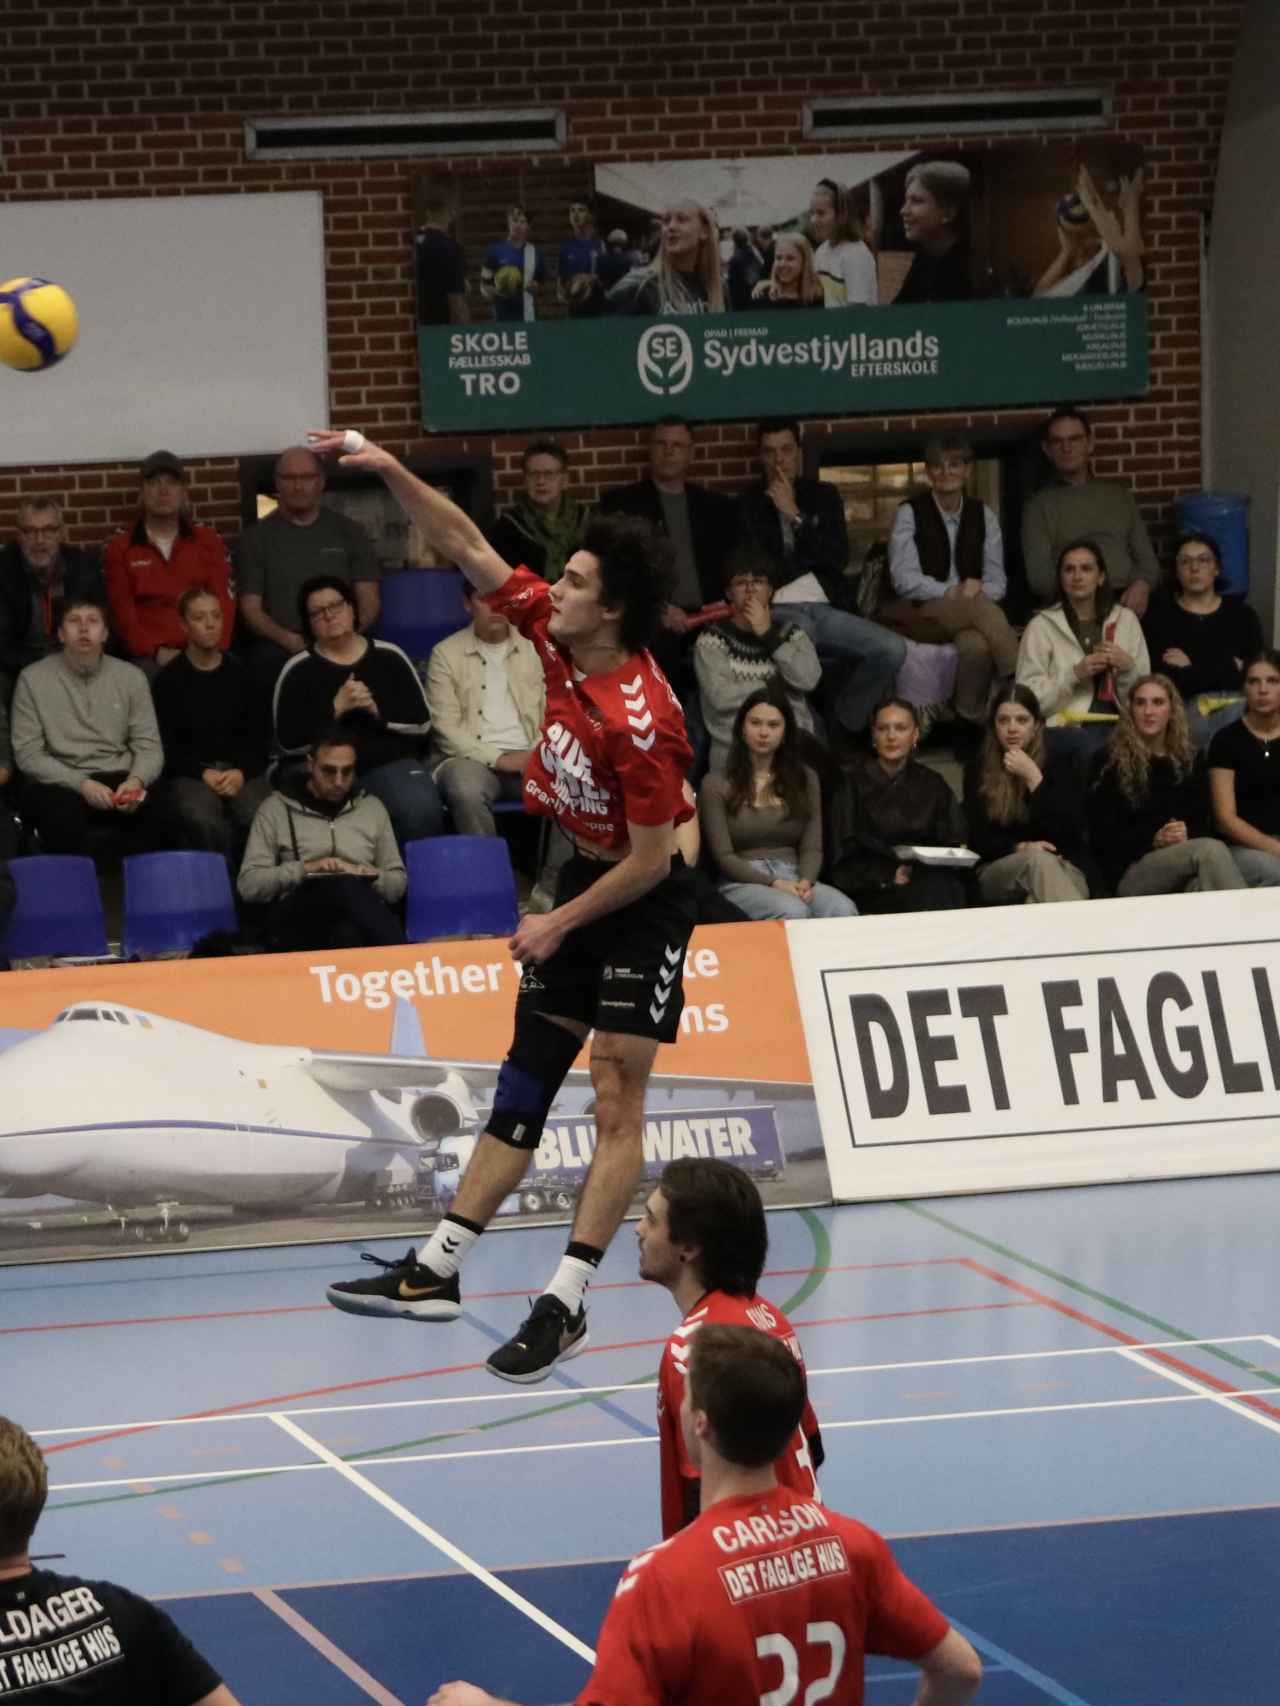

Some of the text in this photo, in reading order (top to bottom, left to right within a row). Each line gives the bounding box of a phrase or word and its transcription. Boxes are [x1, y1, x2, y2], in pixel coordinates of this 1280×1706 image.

[448, 353, 531, 369] FÆLLESSKAB
[451, 331, 528, 353] SKOLE
[651, 337, 678, 359] SE
[704, 330, 939, 377] Sydvestjyllands
[460, 371, 520, 396] TRO
[851, 359, 938, 378] EFTERSKOLE
[310, 955, 504, 1009] Together
[849, 984, 1011, 1119] DET
[534, 1117, 757, 1170] BLU WATER
[712, 1503, 829, 1552] CARLSON
[724, 1541, 846, 1600] DET FAGLIGE HUS
[12, 1640, 89, 1686] FAGLIGE
[82, 1624, 121, 1665] HUS
[756, 1620, 847, 1706] 22
